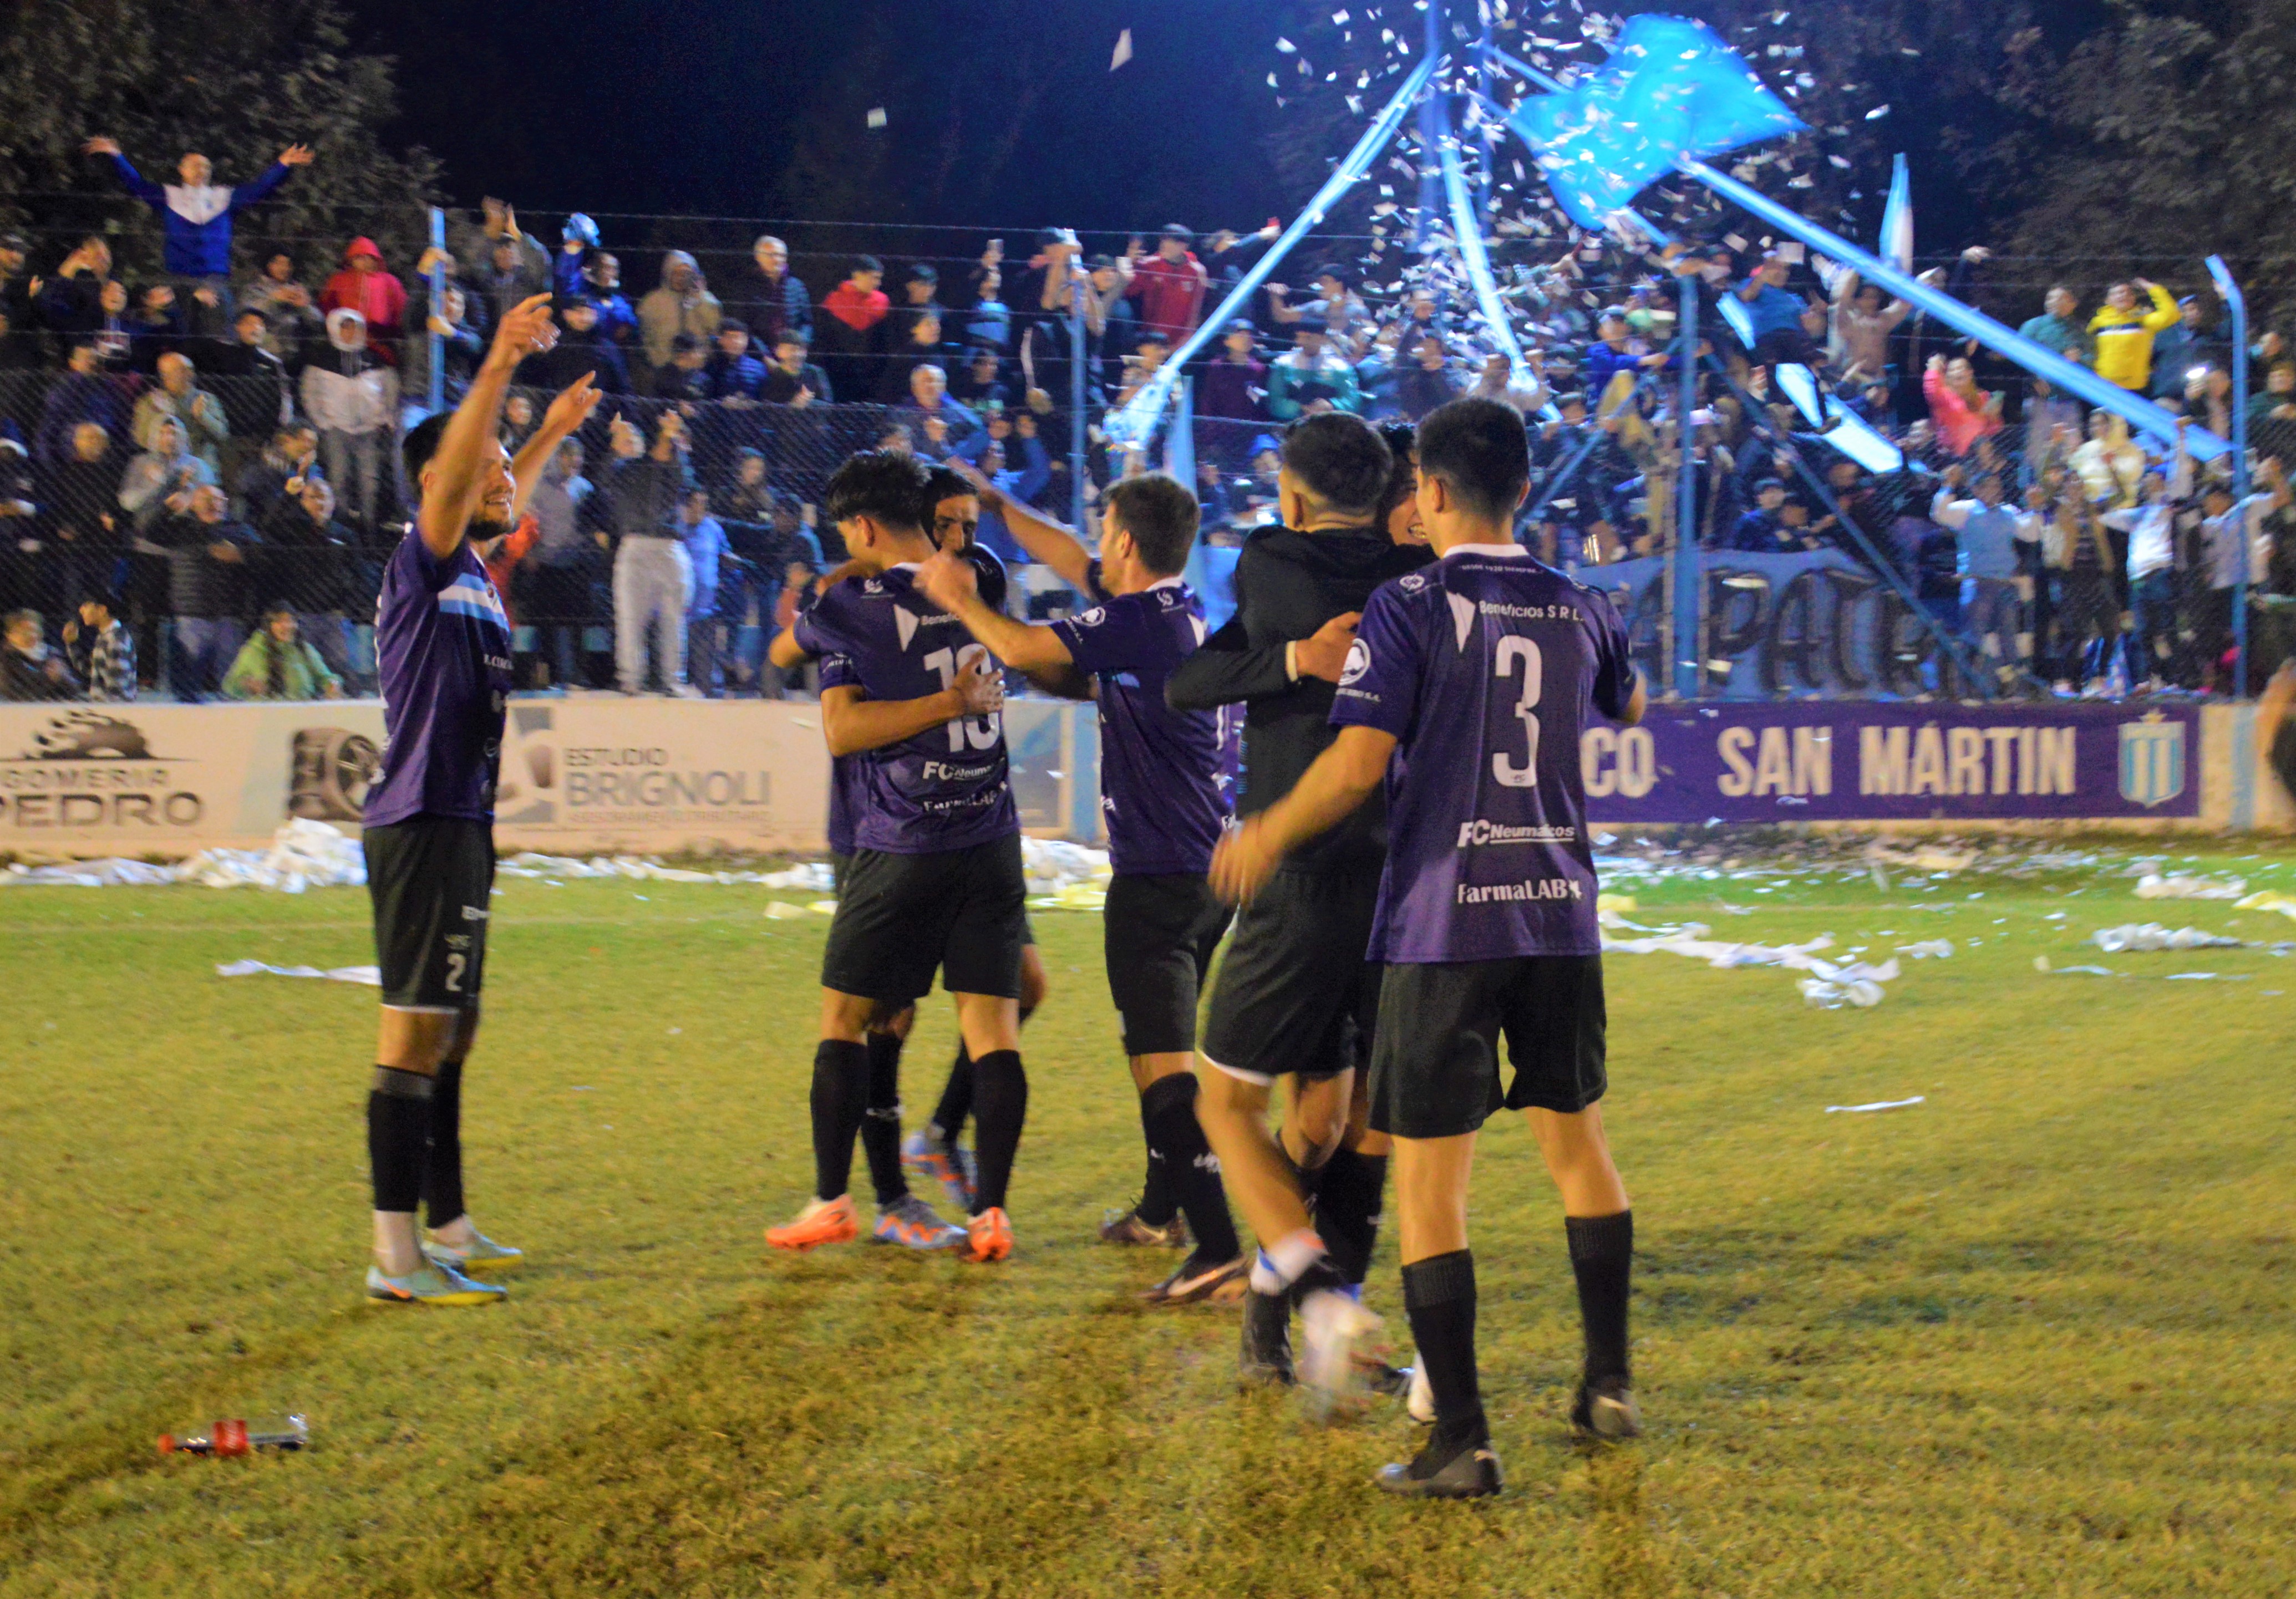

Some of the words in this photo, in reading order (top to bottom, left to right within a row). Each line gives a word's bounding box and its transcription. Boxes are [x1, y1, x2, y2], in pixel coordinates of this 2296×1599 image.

[1492, 634, 1542, 787] 3
[564, 748, 668, 766] ESTUDIO
[1717, 726, 1833, 797] SAN
[1859, 726, 2077, 796] MARTIN
[566, 771, 773, 806] BRIGNOLI
[0, 791, 203, 826] EDRO
[445, 953, 466, 992] 2
